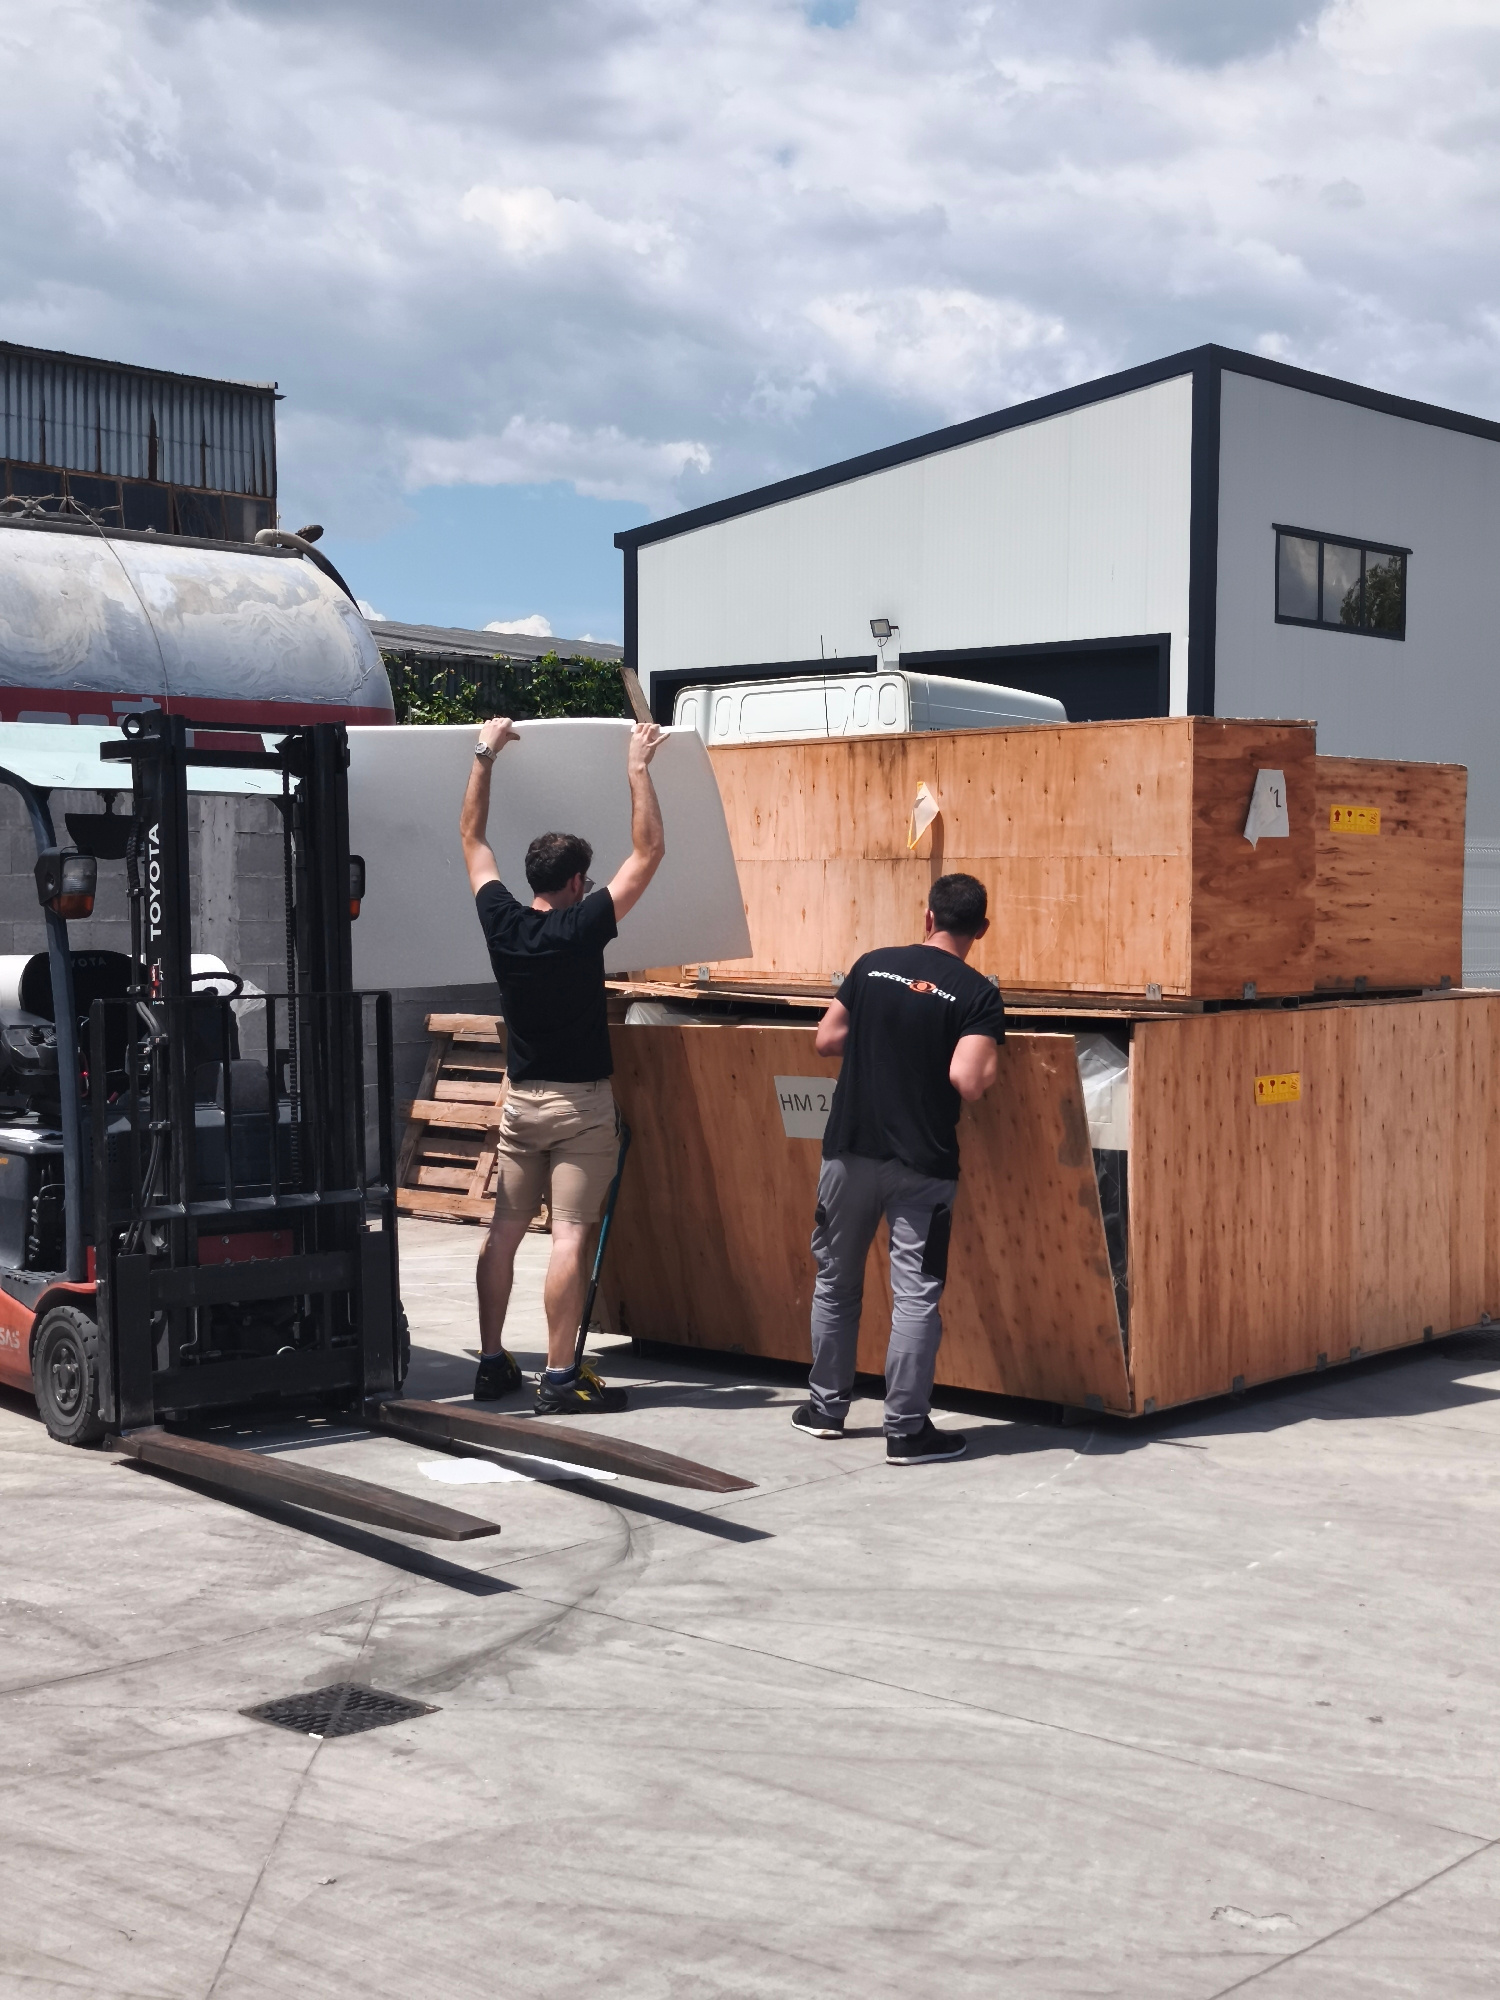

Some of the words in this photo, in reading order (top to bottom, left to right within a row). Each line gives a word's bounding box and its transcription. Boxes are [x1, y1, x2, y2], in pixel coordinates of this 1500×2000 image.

[148, 822, 162, 942] TOYOTA
[780, 1093, 813, 1112] HM
[816, 1093, 830, 1112] 2
